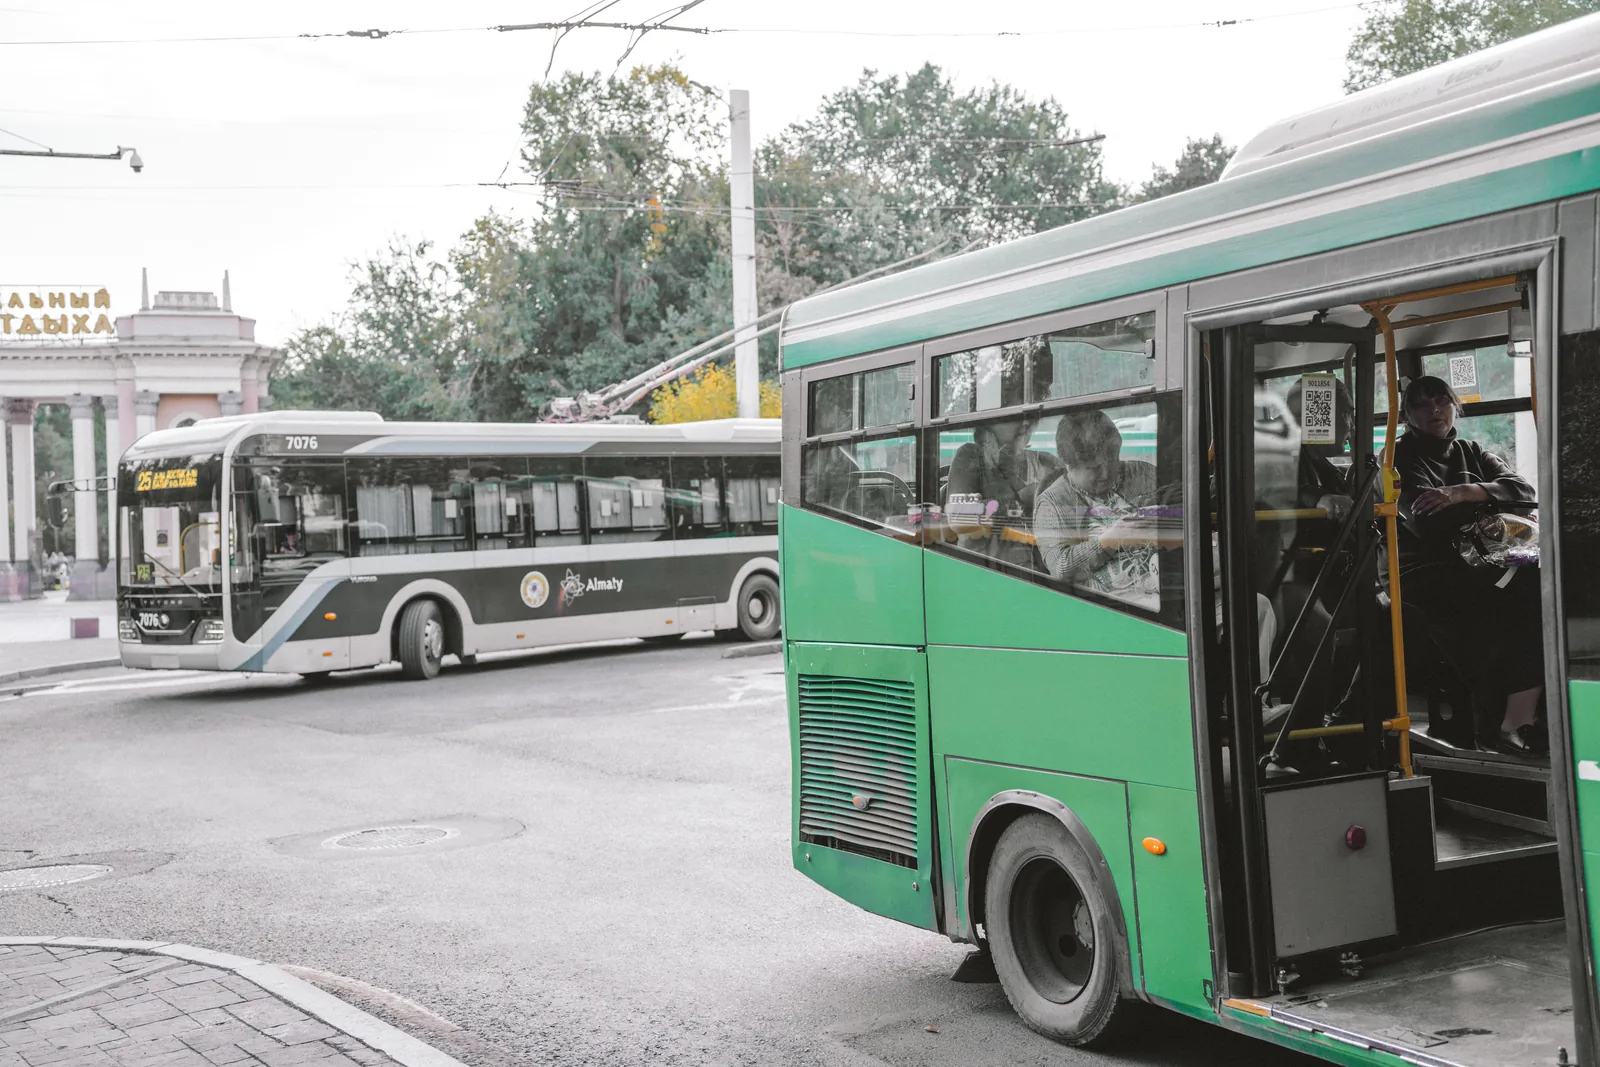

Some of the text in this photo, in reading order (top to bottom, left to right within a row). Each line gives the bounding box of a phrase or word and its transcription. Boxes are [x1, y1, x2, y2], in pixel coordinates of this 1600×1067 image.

[0, 288, 111, 309] ЛЬНЫЙ
[285, 435, 318, 450] 7076
[137, 470, 153, 491] 25
[586, 577, 624, 592] Almaty
[139, 612, 159, 627] 7076
